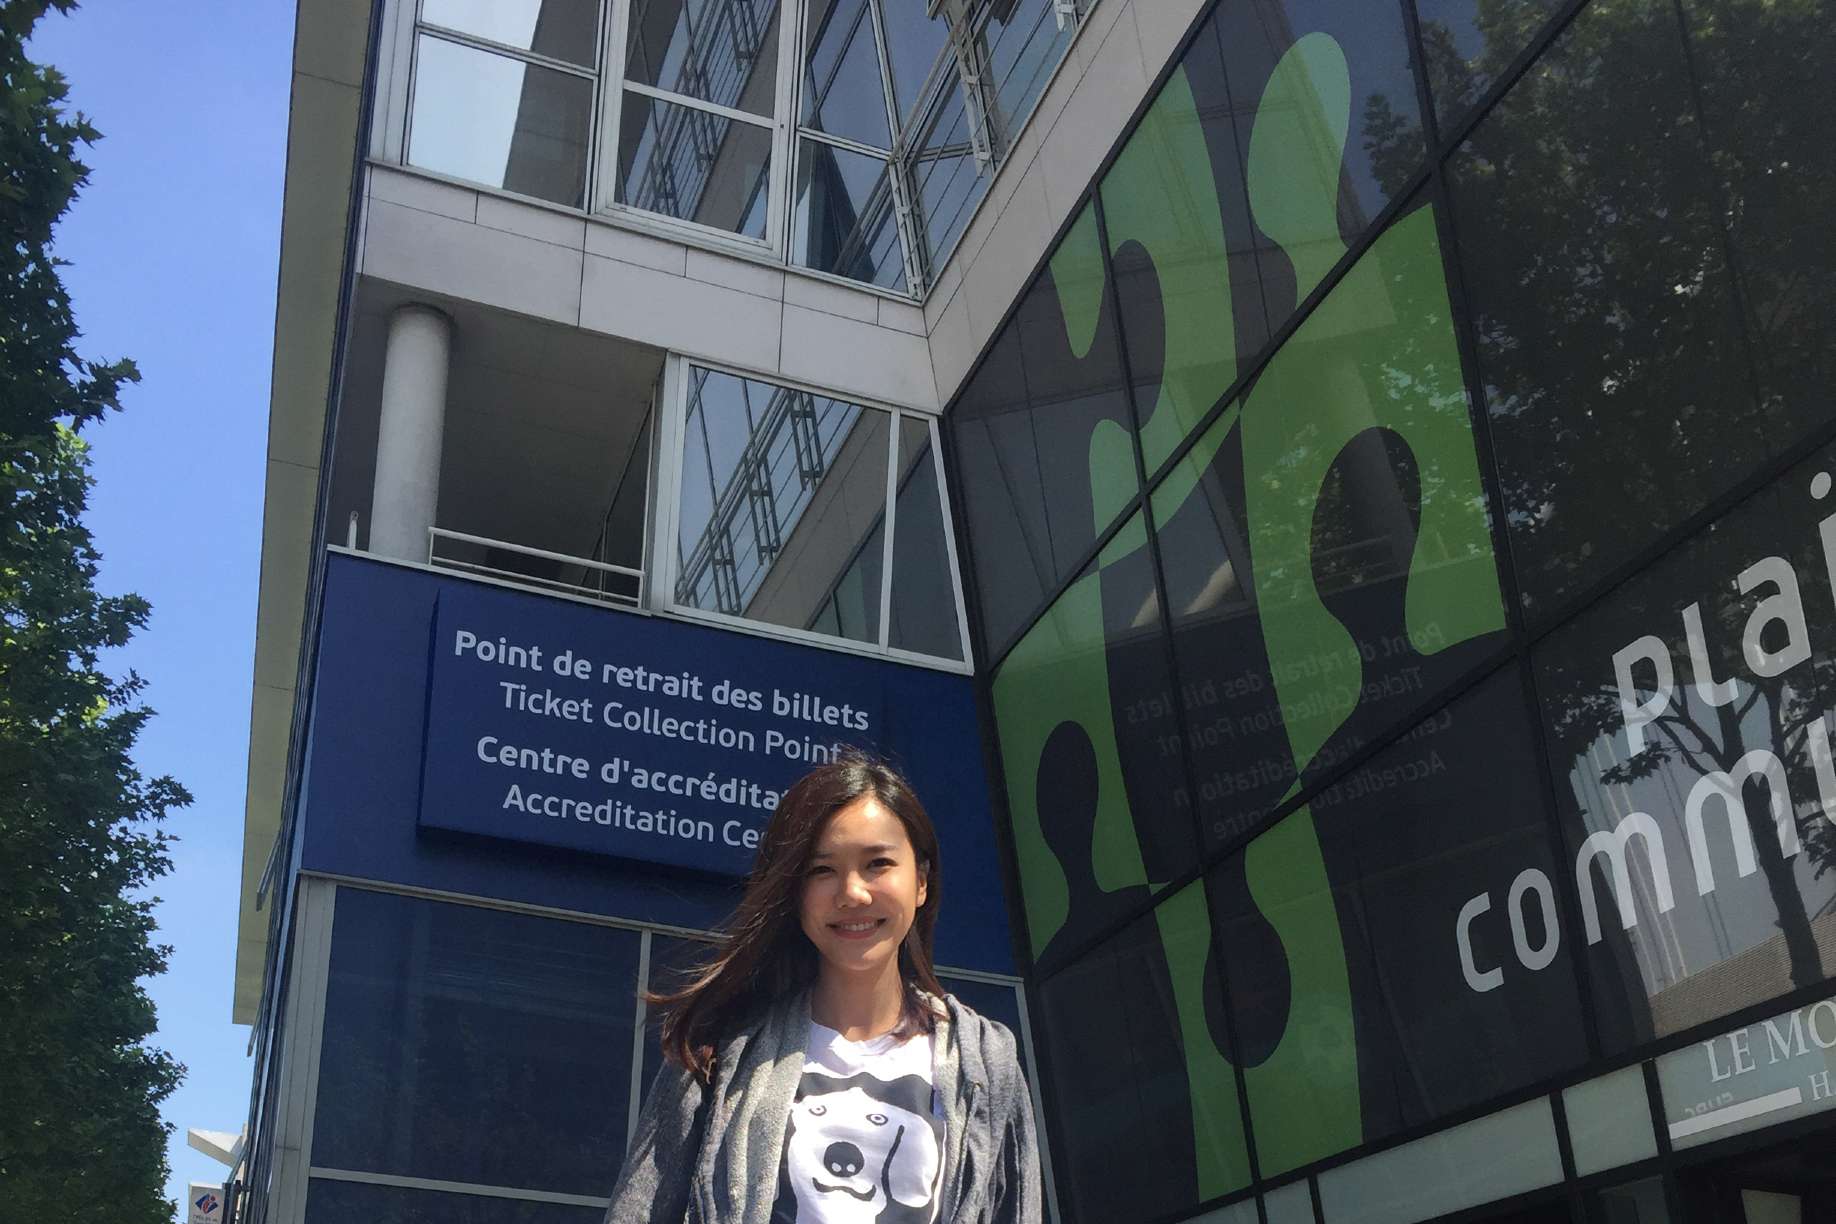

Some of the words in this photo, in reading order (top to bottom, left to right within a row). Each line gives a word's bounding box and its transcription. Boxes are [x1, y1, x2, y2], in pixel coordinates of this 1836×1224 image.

[454, 630, 543, 672] Point
[553, 649, 592, 680] de
[602, 663, 704, 701] retrait
[711, 679, 763, 711] des
[772, 688, 869, 731] billets
[499, 681, 593, 723] Ticket
[603, 701, 755, 752] Collection
[765, 729, 845, 765] Point
[477, 736, 590, 779] Centre
[502, 784, 714, 842] Accreditation
[722, 820, 768, 849] Ce
[1703, 1028, 1756, 1083] LE
